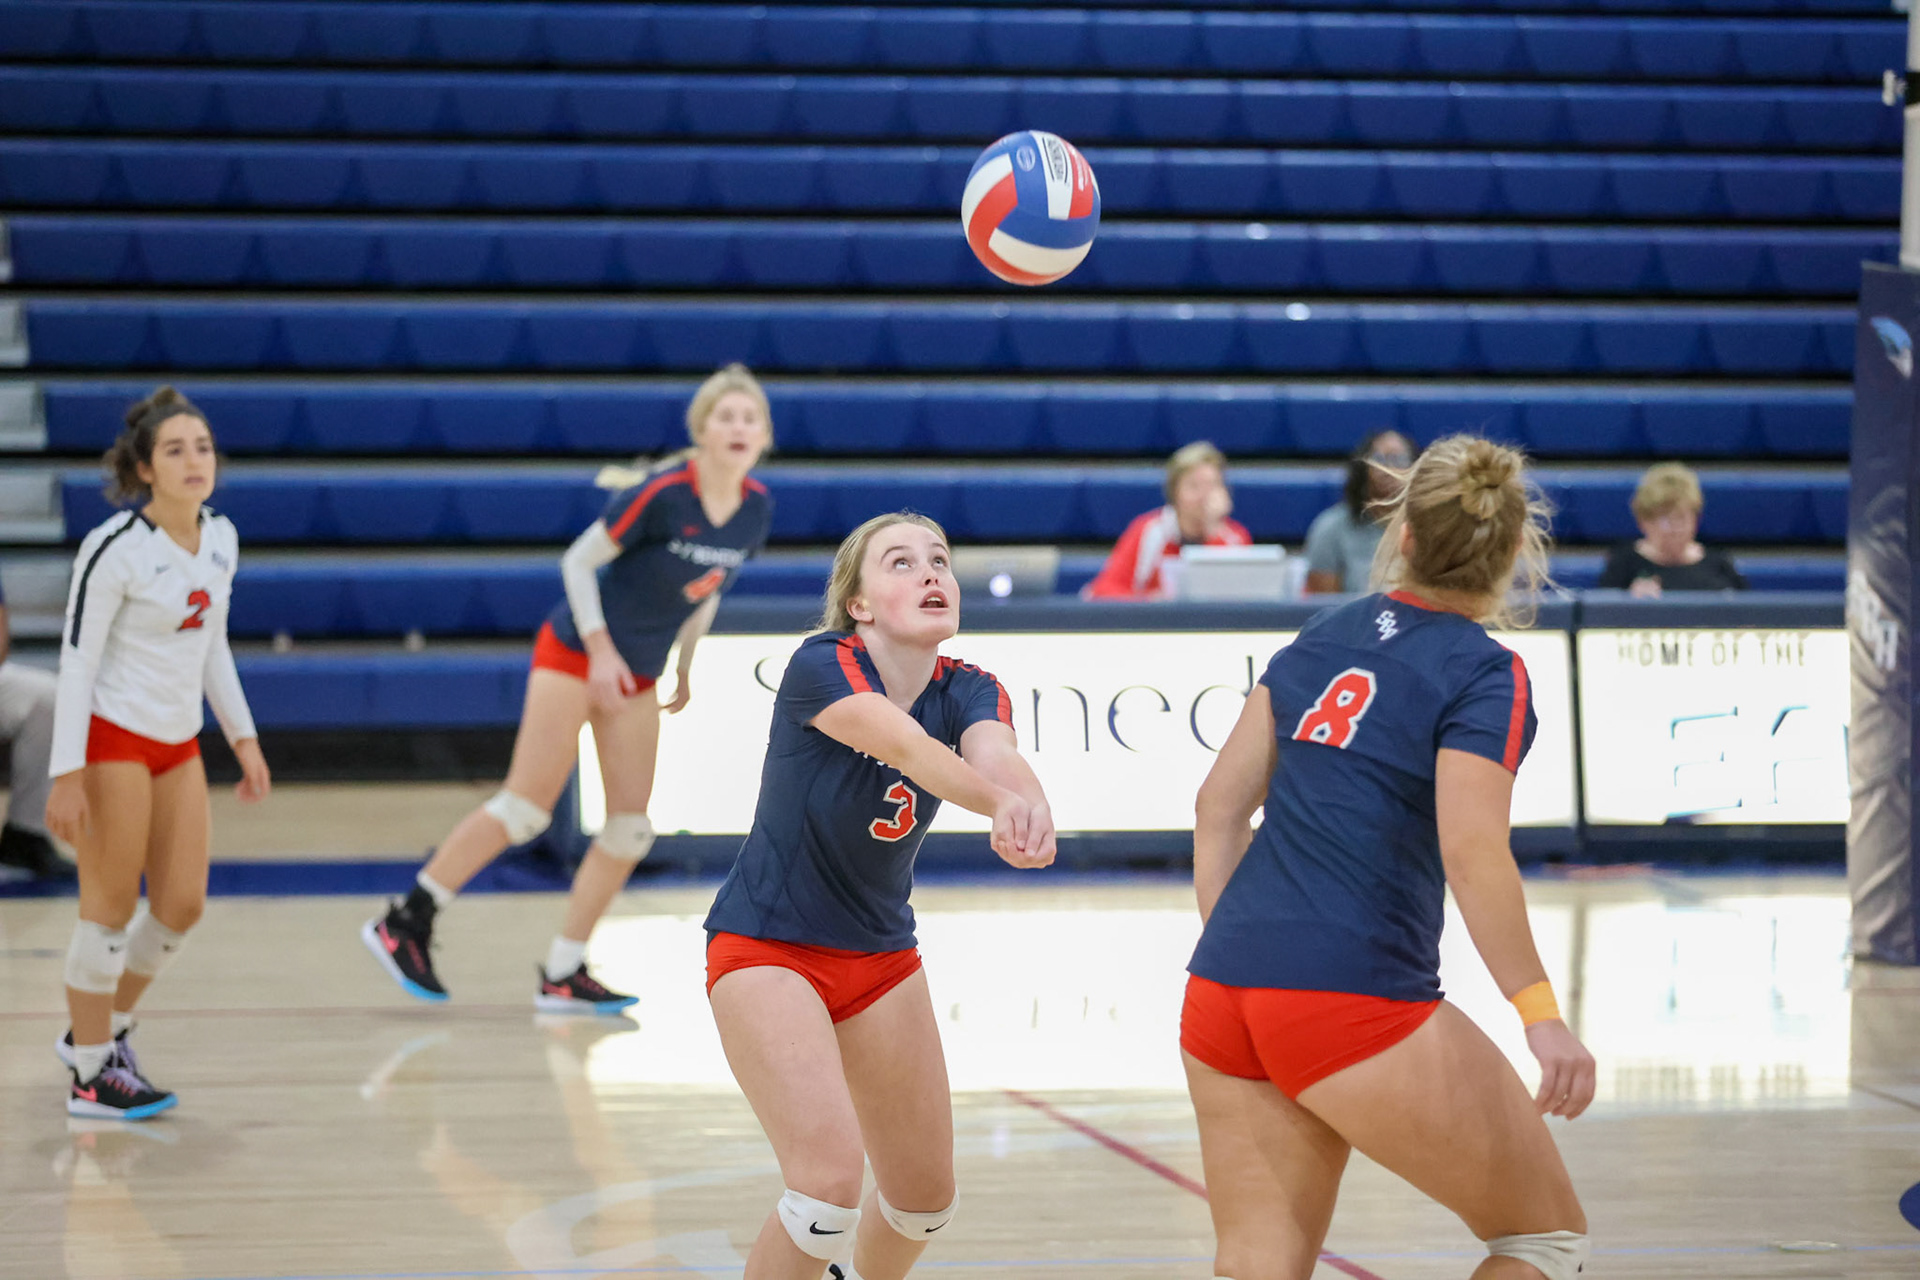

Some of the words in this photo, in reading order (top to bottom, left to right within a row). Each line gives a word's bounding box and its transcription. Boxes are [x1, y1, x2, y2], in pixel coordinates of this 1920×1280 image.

[176, 588, 211, 633] 2
[1291, 667, 1378, 750] 8
[868, 780, 918, 843] 3
